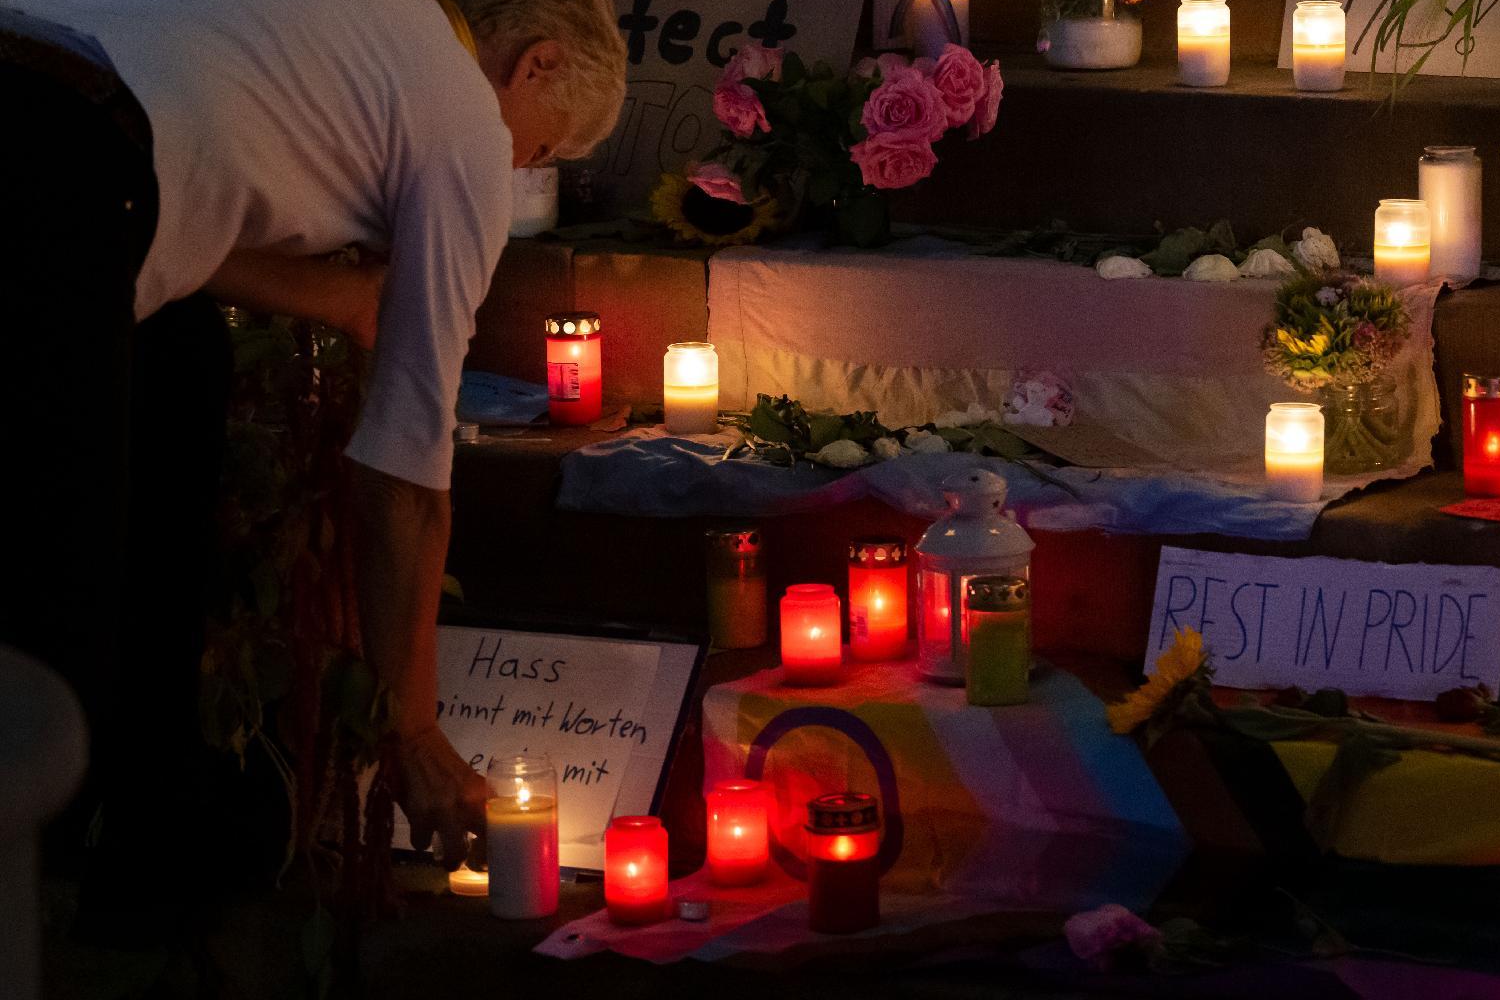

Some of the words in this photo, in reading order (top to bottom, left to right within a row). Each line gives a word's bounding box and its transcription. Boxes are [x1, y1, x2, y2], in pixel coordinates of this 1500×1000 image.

[1159, 575, 1280, 664] REST
[1295, 585, 1347, 671] IN
[1358, 588, 1489, 681] PRIDE
[468, 636, 569, 684] Hass
[512, 701, 555, 728] mit
[559, 700, 648, 745] Worten
[562, 758, 610, 786] mit
